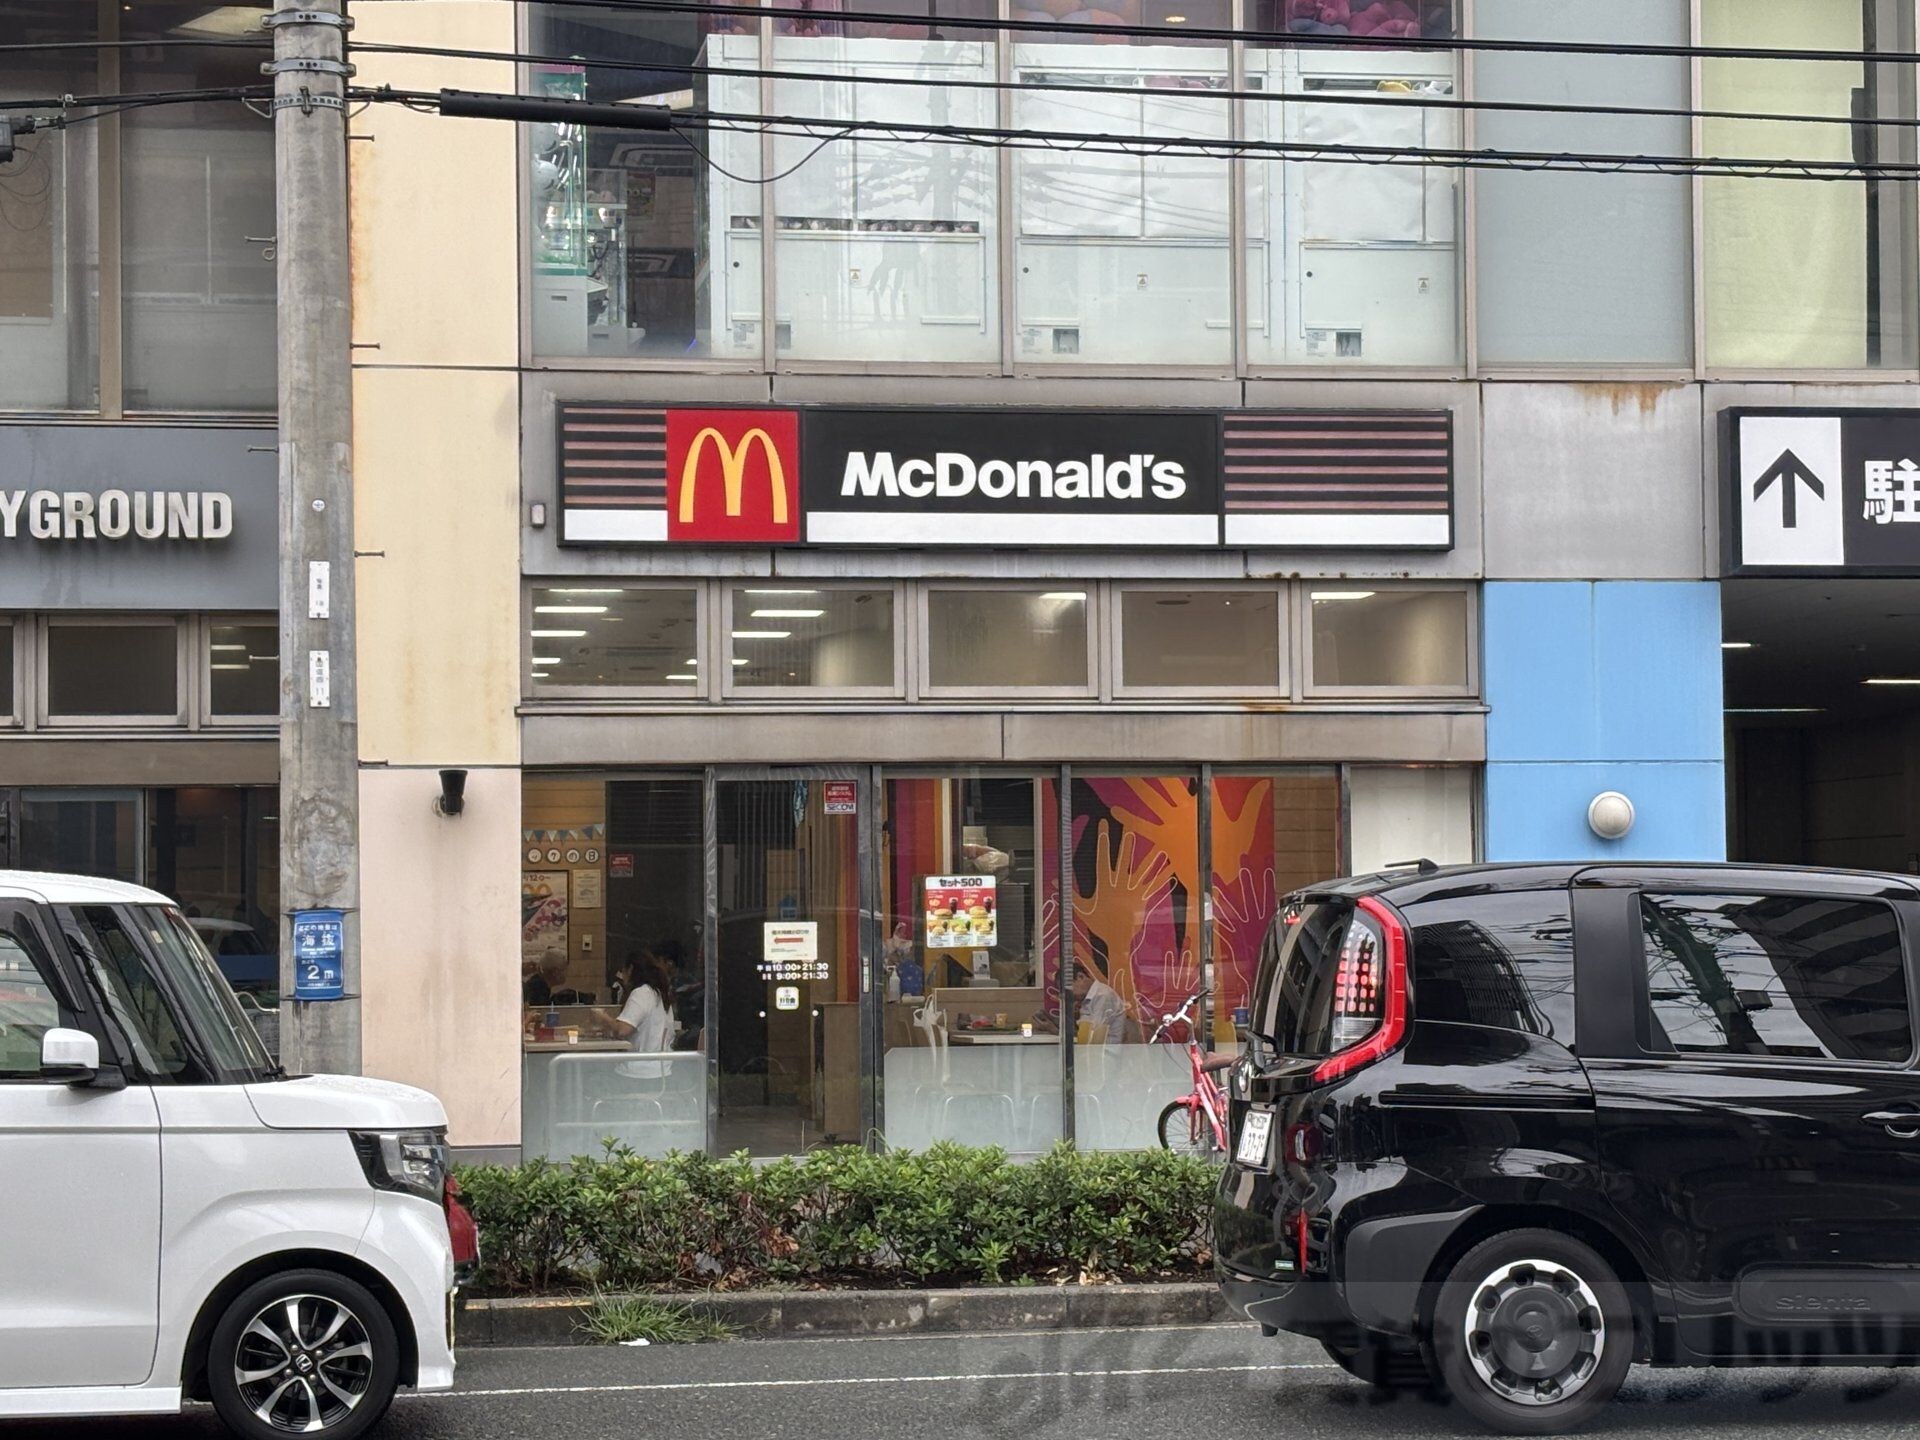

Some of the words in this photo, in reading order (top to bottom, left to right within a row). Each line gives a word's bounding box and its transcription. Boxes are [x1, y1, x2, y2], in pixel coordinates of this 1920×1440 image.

[840, 451, 1187, 499] McDonald's
[1863, 458, 1920, 525] 駐
[0, 489, 233, 539] YGROUND
[307, 965, 320, 980] 2
